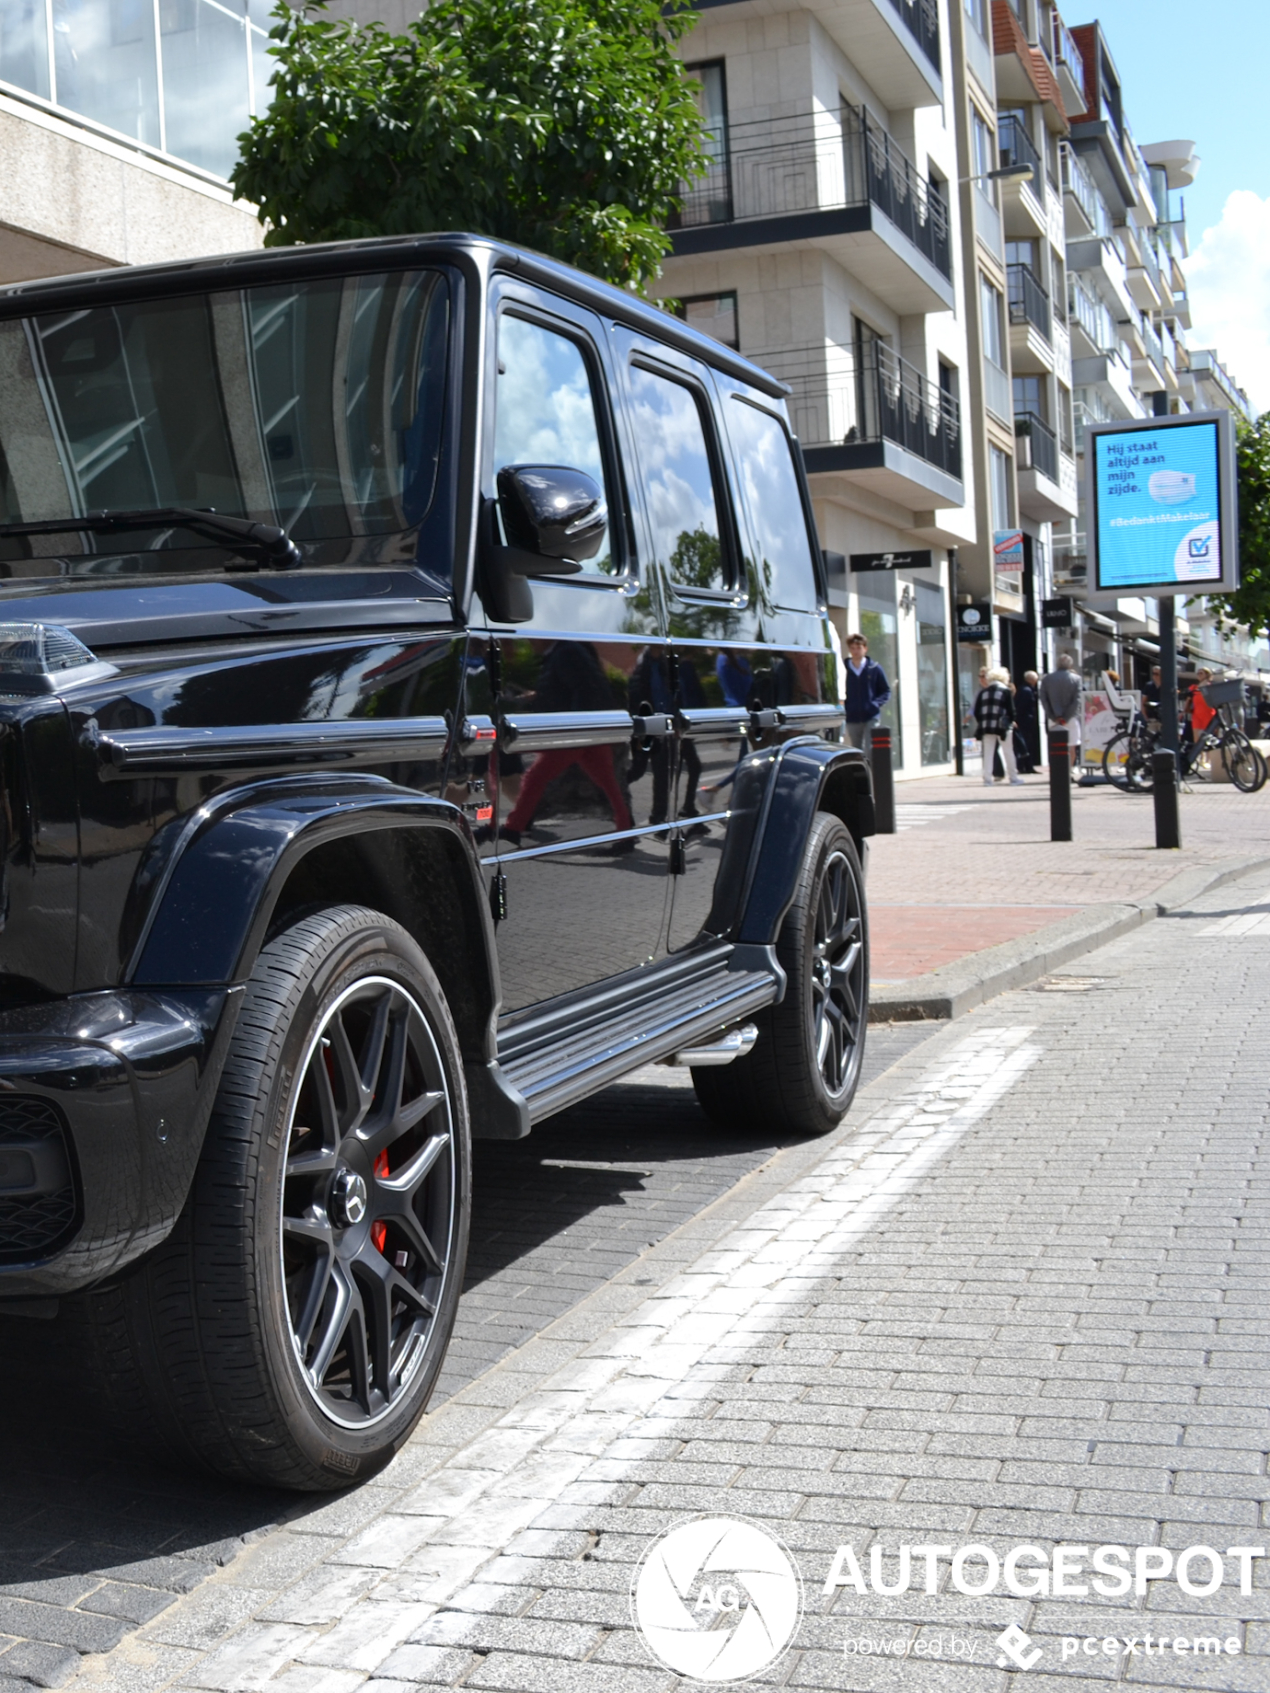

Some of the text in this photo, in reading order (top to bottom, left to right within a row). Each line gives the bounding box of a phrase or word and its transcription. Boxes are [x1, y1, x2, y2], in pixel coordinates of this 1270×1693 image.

[1107, 441, 1158, 456] Hij staat
[1107, 454, 1166, 468] altijd aan
[1107, 470, 1136, 482] mijn
[1107, 483, 1142, 496] zijde.
